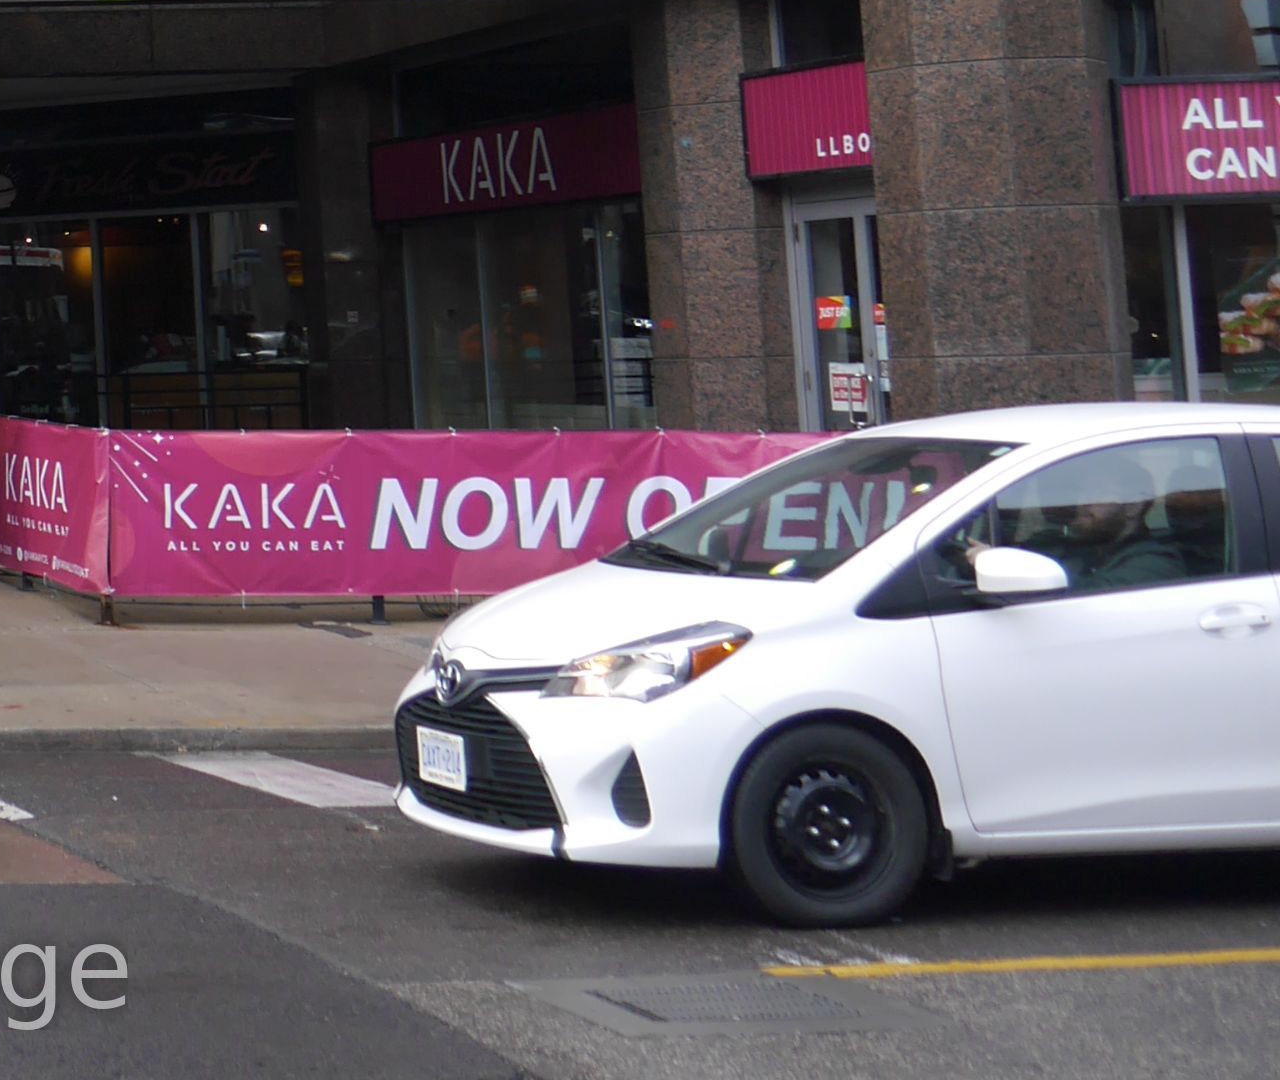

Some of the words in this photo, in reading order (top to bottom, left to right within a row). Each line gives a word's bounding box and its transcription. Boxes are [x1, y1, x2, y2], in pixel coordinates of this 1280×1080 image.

[1182, 97, 1264, 130] ALL
[816, 132, 871, 157] LLBO
[441, 127, 557, 204] KAKA
[1186, 146, 1277, 180] CAN
[5, 452, 68, 513] KAKA
[6, 513, 19, 526] ALL
[22, 517, 36, 530] YOU
[37, 520, 52, 534] CAN
[54, 523, 69, 537] EAT
[164, 483, 346, 529] KAKA
[370, 476, 605, 550] NOW
[167, 540, 200, 551] ALL
[213, 540, 250, 551] YOU
[262, 540, 299, 551] CAN
[311, 540, 345, 551] EAT
